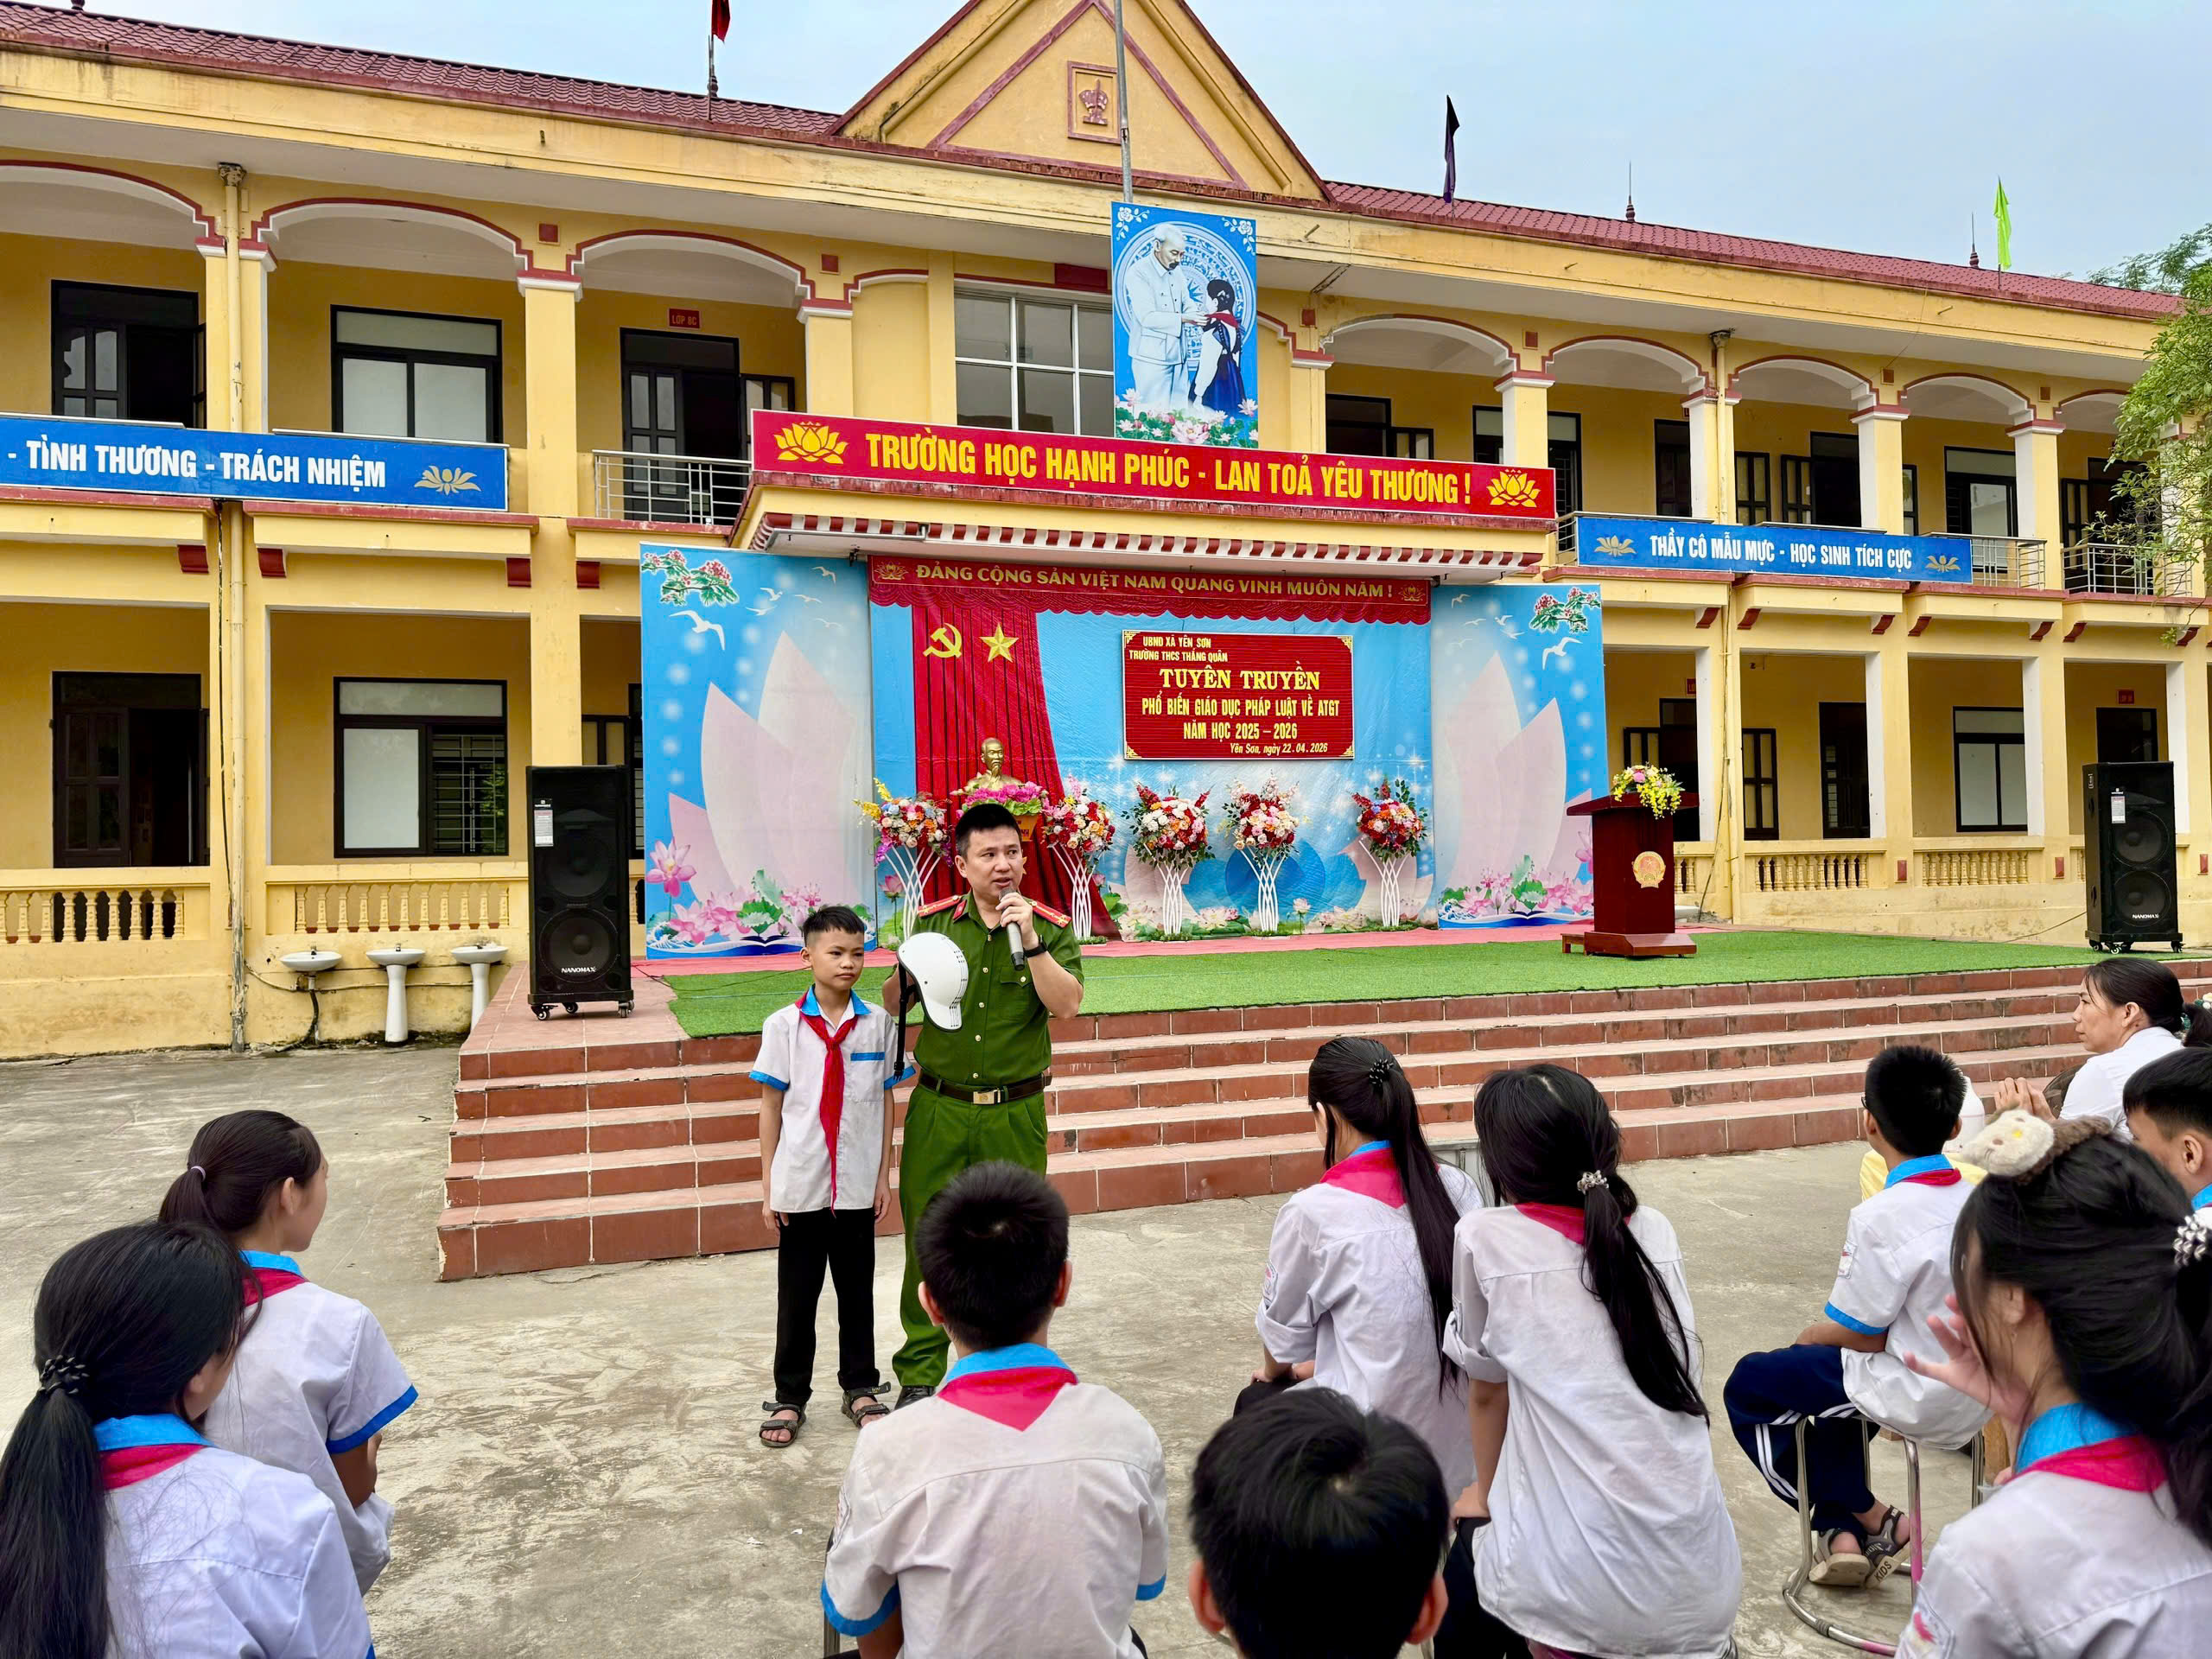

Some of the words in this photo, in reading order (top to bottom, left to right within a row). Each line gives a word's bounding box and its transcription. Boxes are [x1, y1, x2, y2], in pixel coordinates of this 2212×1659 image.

[26, 435, 86, 471] TÌNH
[94, 444, 197, 478] THƯƠNG
[220, 448, 300, 484] TRÁCH
[307, 455, 385, 493] NHIỆM
[865, 427, 975, 474] TRƯỜNG
[985, 442, 1037, 485] HỌC
[1046, 448, 1116, 490] HẠNH
[1124, 448, 1189, 488] PHÚC
[1215, 459, 1261, 492] LAN
[1268, 454, 1313, 496] TOẢ
[1320, 461, 1363, 499] YÊU
[1370, 468, 1459, 505] THƯƠNG
[1649, 527, 1685, 558] THẦY
[1688, 533, 1707, 559] CÔ
[1711, 531, 1742, 561] MẪU
[1745, 540, 1776, 567] MỰC
[1790, 546, 1815, 569] HỌC
[1821, 546, 1850, 566] SINH
[1855, 543, 1883, 568] TÍCH
[1887, 548, 1912, 572] CỰC
[916, 561, 973, 581] ĐẢNG
[977, 565, 1032, 585] CỘNG
[1037, 567, 1076, 585] SẢN
[1080, 570, 1119, 590] VIỆT
[1124, 575, 1166, 589] NAM
[1171, 576, 1235, 594] QUANG
[1238, 580, 1282, 594] VINH
[1287, 579, 1340, 595] MUÔN
[1345, 582, 1383, 597] NĂM
[1143, 636, 1163, 647] UBND
[1166, 633, 1176, 646] XÃ
[1179, 635, 1192, 647] YÊN
[1196, 638, 1211, 648] SƠN
[1129, 649, 1159, 661] TRƯỜNG
[1161, 651, 1179, 661] THCS
[1208, 651, 1228, 663] QUÂN
[1160, 664, 1231, 689] TUYÊN
[1240, 660, 1320, 690] TRUYỀN
[1141, 690, 1162, 715] PHỔ
[1167, 692, 1190, 716] BIẾN
[1194, 696, 1217, 716] GIÁO
[1222, 699, 1240, 719] DỤC
[1245, 696, 1270, 716] PHÁP
[1275, 696, 1297, 719] LUẬT
[1301, 694, 1313, 716] VỀ
[1318, 700, 1339, 716] ATGT
[1184, 720, 1206, 740] NĂM
[1211, 721, 1231, 742] HỌC
[1235, 722, 1260, 740] 2025
[1274, 722, 1298, 740] 2026
[1230, 743, 1243, 753] Yên
[1245, 743, 1261, 754] Sơn,
[1263, 743, 1281, 756] ngày
[1874, 1561, 1891, 1581] KIDS
